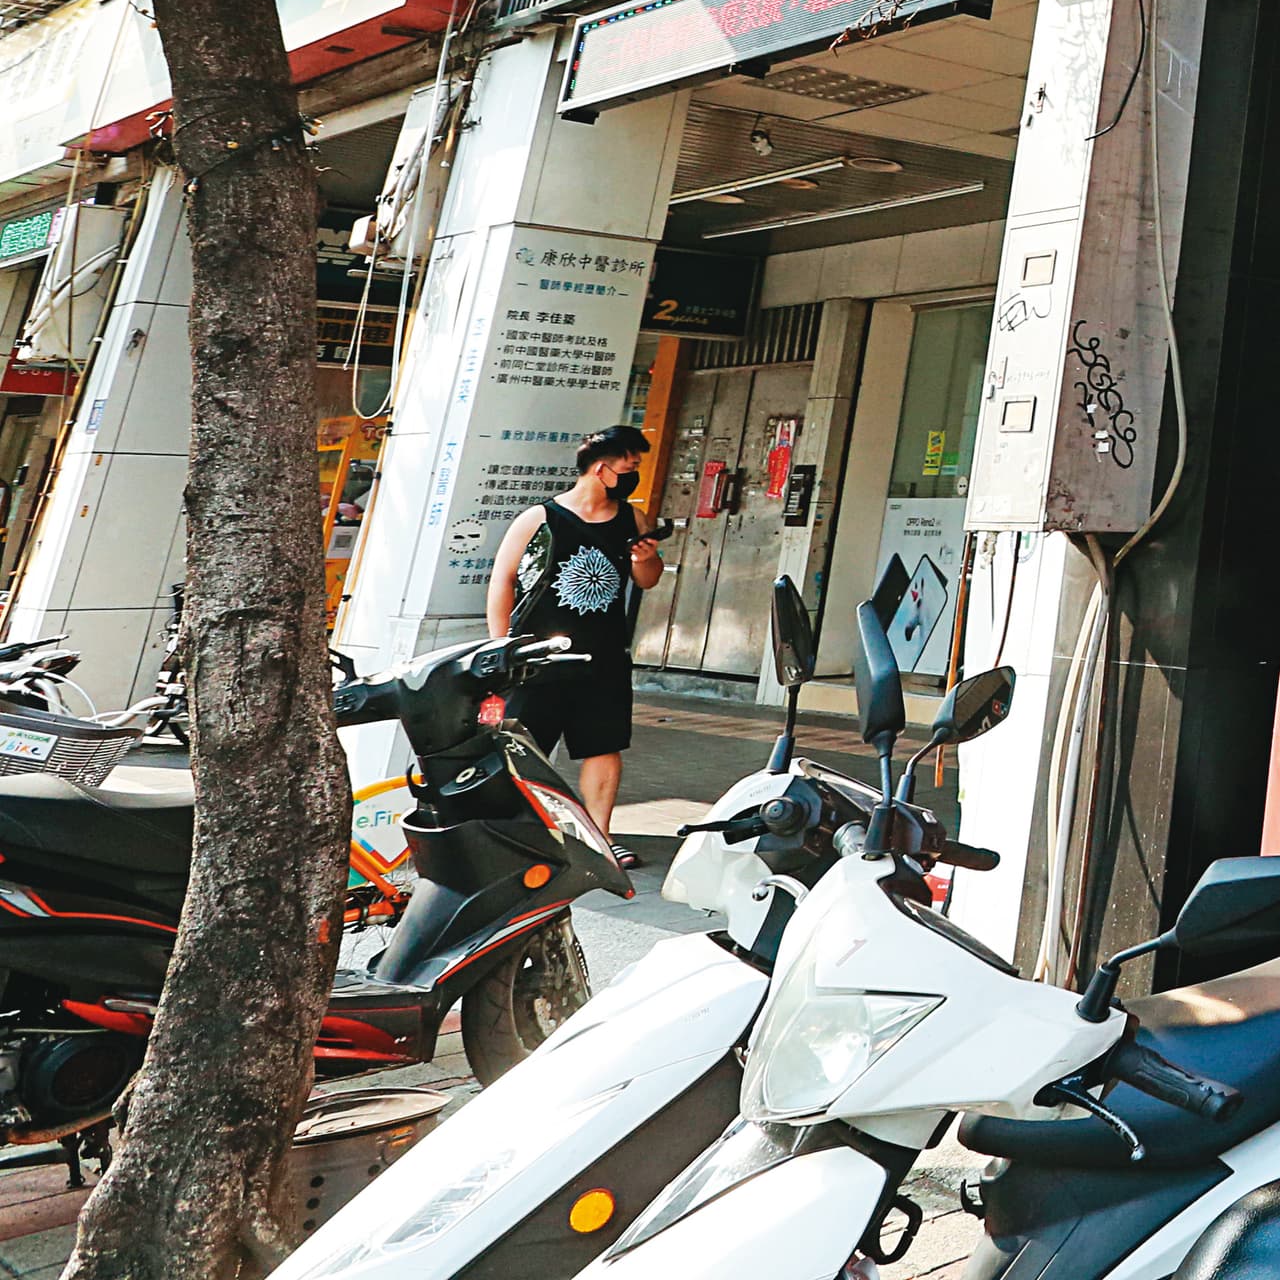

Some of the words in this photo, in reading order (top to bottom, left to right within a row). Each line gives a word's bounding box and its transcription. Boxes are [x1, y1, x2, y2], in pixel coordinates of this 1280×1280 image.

[541, 249, 645, 276] 康欣中醫診所
[539, 278, 617, 296] 醫師學經歷簡介
[506, 310, 531, 322] 院長
[535, 312, 577, 326] 李佳築
[505, 329, 609, 348] 國家中醫師考試及格
[503, 344, 617, 362] 前中國醫藥大學中醫師
[500, 359, 614, 377] 前同仁堂診所主治醫師
[501, 429, 586, 442] 康欣診所服務宗
